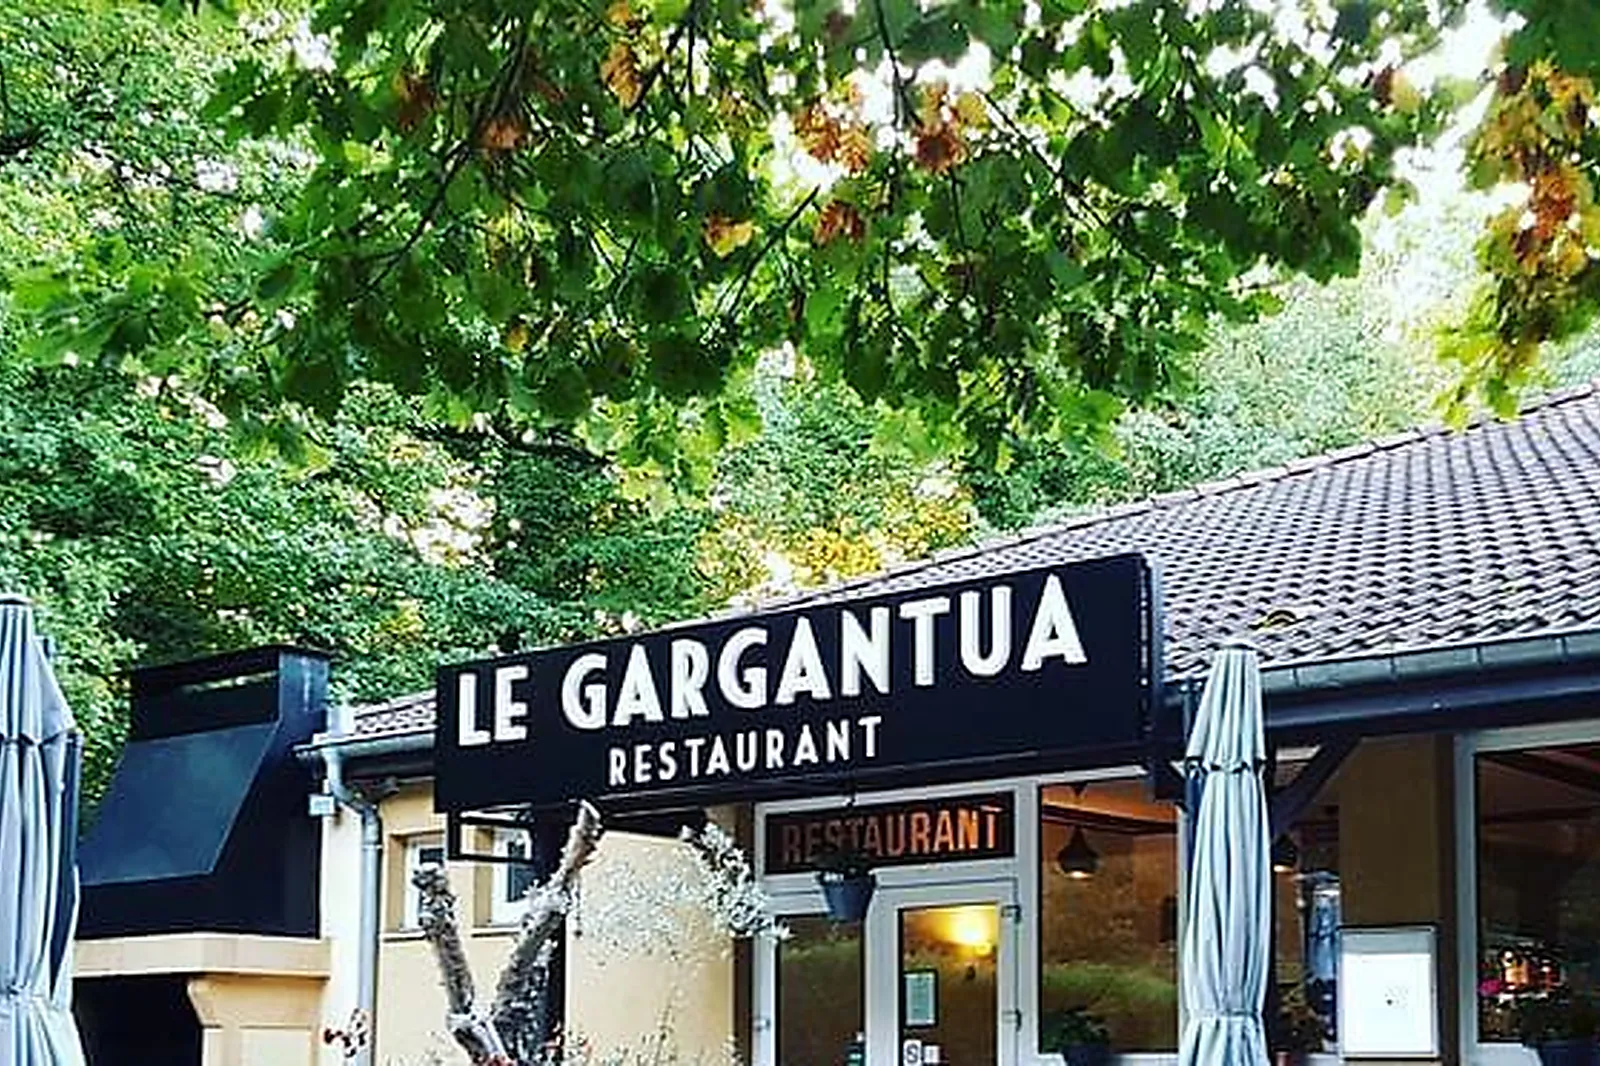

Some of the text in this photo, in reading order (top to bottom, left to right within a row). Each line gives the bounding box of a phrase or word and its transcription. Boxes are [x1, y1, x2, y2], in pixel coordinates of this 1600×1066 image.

[458, 573, 1088, 746] LE GARGANTUA
[609, 715, 882, 786] RESTAURANT
[782, 804, 1003, 863] RESTAURANT
